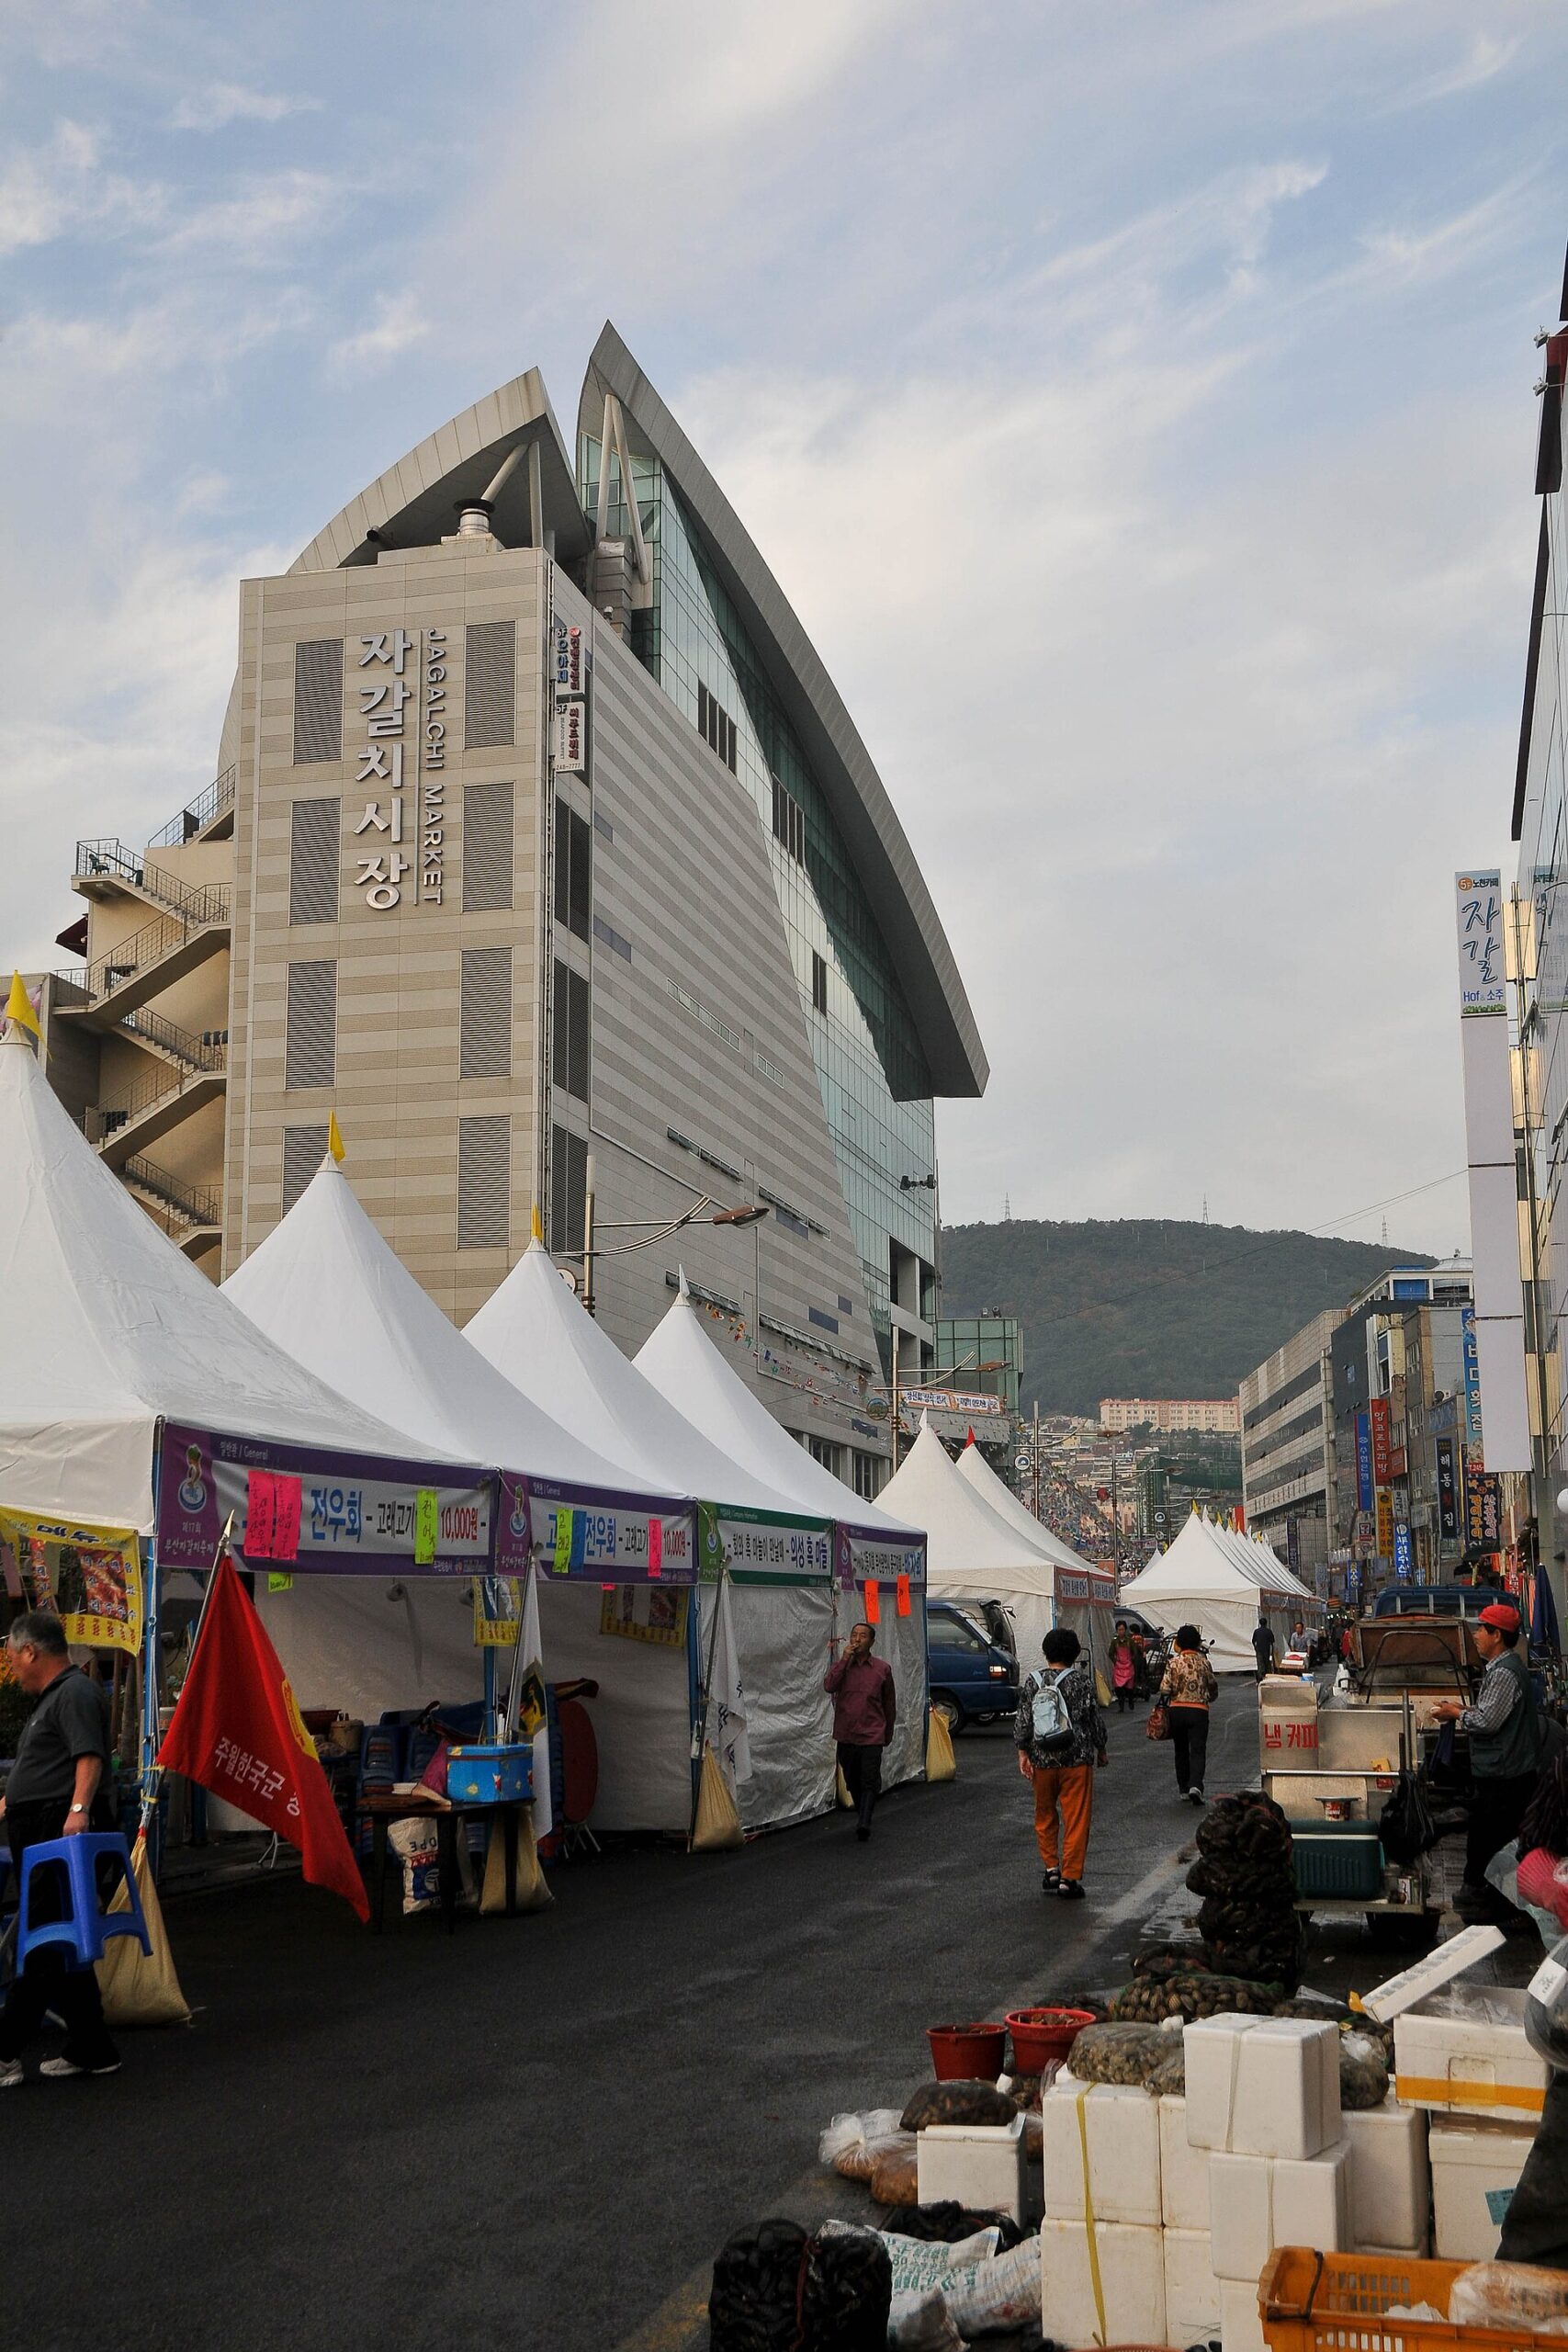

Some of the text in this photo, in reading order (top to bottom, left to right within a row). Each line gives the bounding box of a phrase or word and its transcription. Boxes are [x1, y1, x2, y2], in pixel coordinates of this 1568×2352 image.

[556, 628, 568, 638] 6F
[353, 628, 412, 910] 자갈치시장
[423, 628, 446, 905] JAGALCHI MARKET
[1472, 877, 1499, 888] 노천카페
[1461, 897, 1500, 984] 자갈
[1463, 989, 1480, 1001] Hof
[1487, 989, 1504, 1001] 소주
[1440, 1453, 1453, 1527] 해동집
[441, 1506, 479, 1544] 10,000원
[1264, 1723, 1318, 1749] 냉 커피
